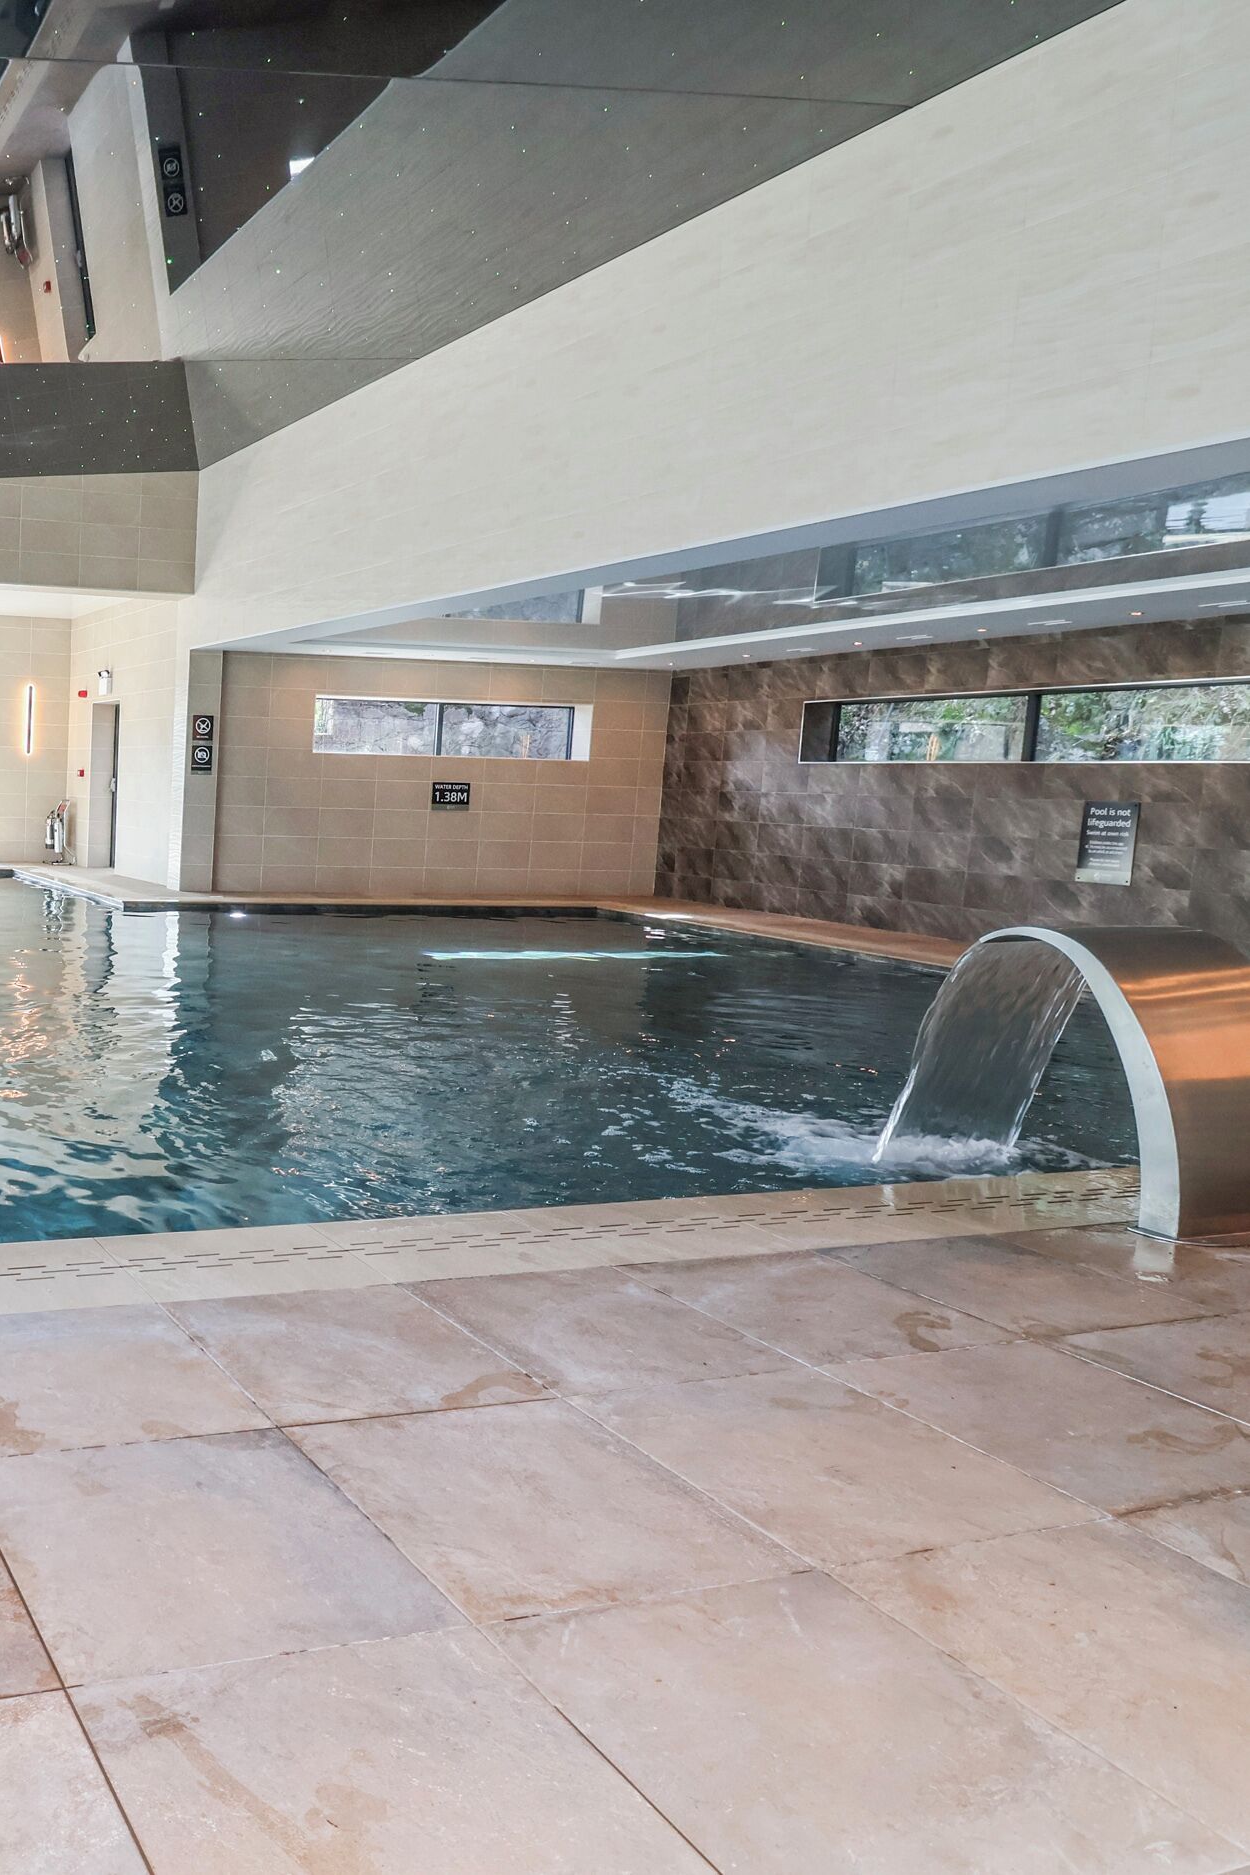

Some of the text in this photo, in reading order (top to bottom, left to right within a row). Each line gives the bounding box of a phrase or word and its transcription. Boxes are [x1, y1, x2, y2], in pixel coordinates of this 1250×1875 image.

[435, 791, 468, 802] 1.38M
[1090, 807, 1131, 817] Pool is not
[1087, 817, 1132, 828] lifeguarded
